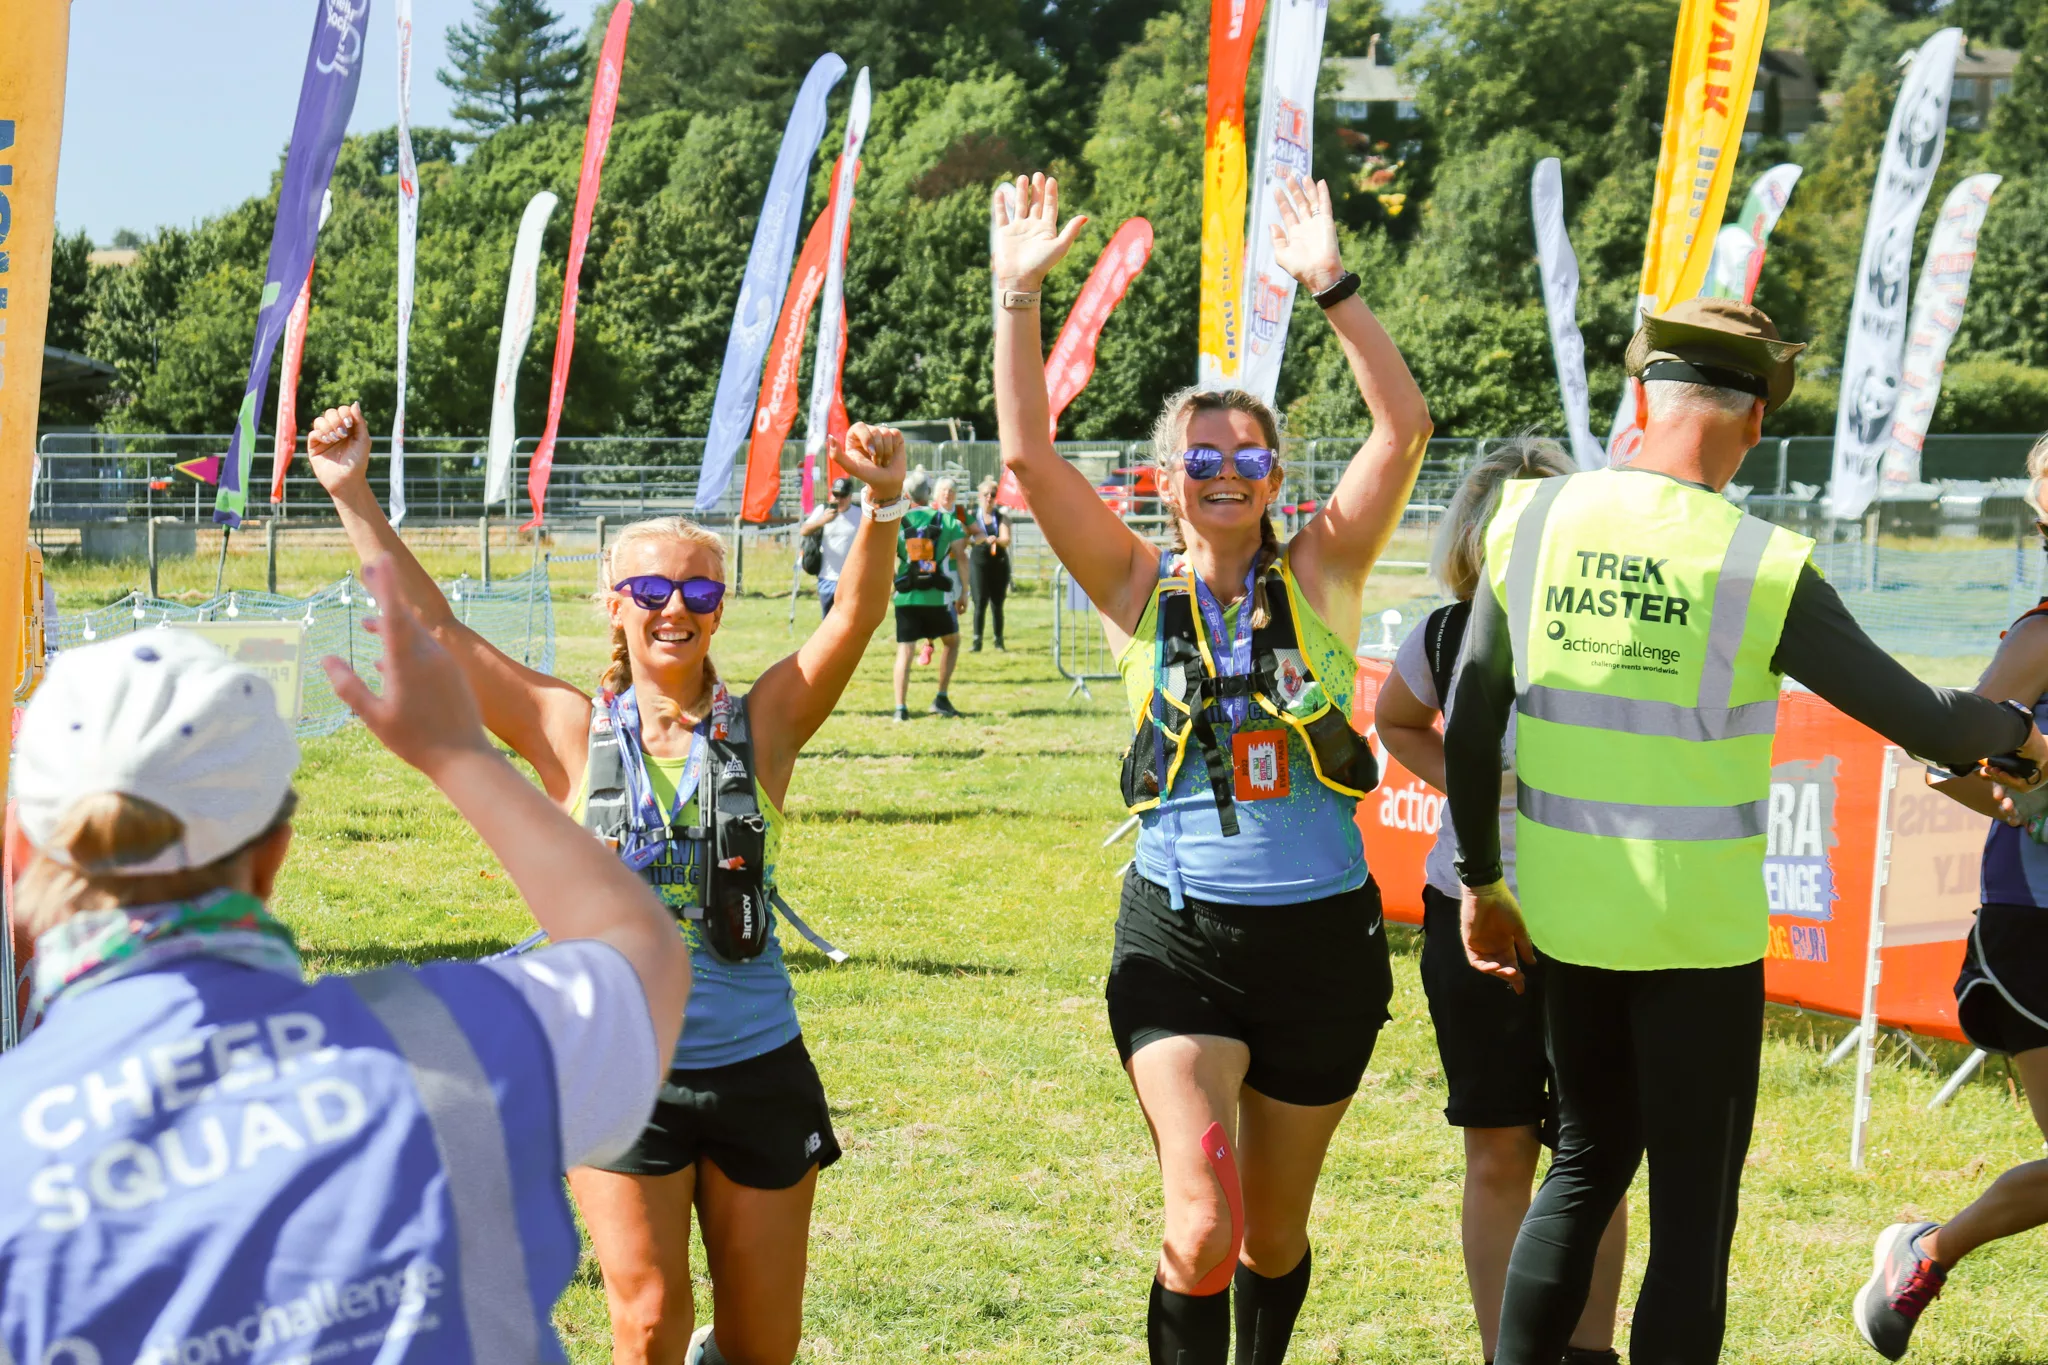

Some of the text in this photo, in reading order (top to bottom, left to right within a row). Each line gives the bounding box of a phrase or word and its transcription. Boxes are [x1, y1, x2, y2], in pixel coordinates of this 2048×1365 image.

[768, 265, 817, 416] actionchallenge
[1577, 550, 1669, 585] TREK
[1545, 585, 1690, 626] MASTER
[1562, 637, 1681, 665] actionchallenge
[1591, 660, 1620, 670] challenge
[1643, 664, 1679, 676] worldwide
[1277, 739, 1285, 760] PASS
[1767, 783, 1824, 856] RA
[1766, 863, 1824, 913] ENGE
[742, 893, 751, 940] AONIJIE
[1791, 925, 1829, 963] RUN
[20, 1012, 341, 1151] CHEER
[29, 1077, 368, 1233] SQUAD
